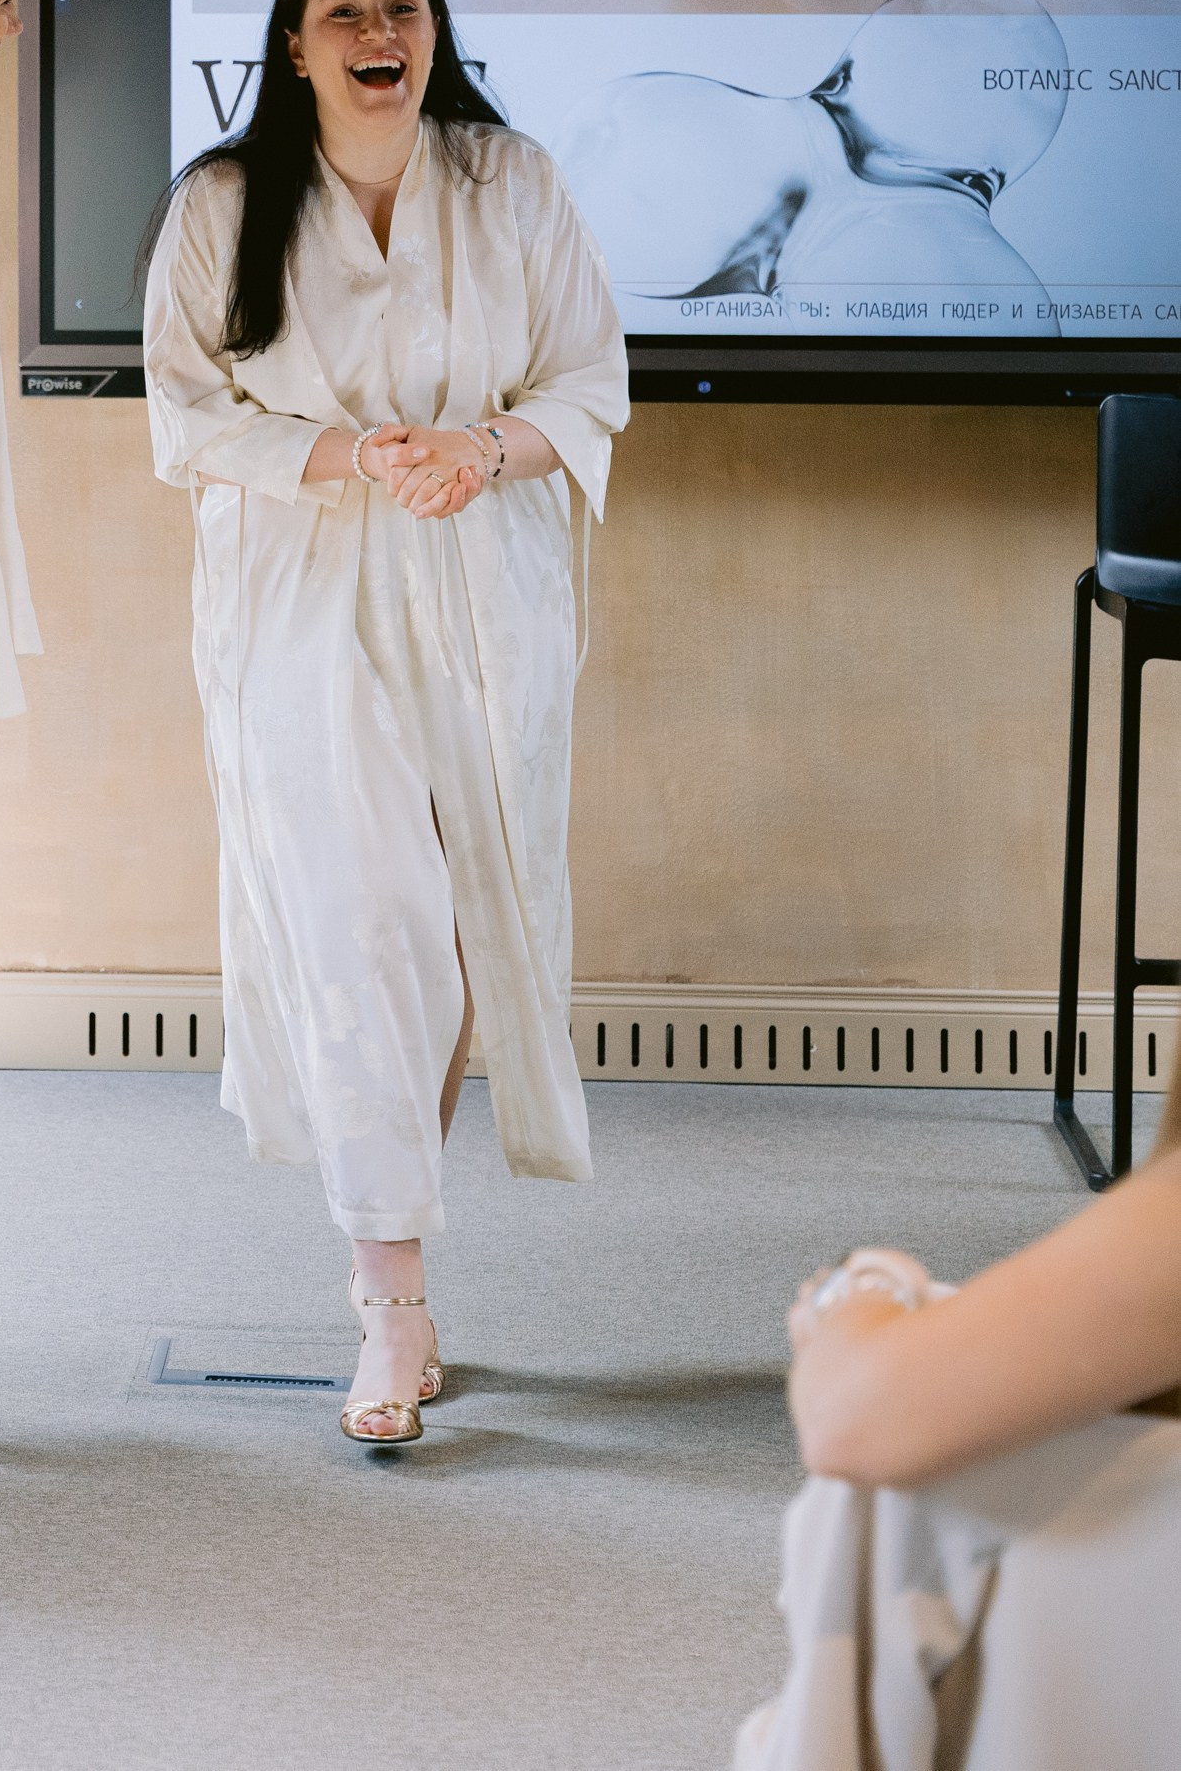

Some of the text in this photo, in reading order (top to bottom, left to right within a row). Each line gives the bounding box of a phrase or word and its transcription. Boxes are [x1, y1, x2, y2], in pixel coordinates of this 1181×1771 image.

[983, 69, 1093, 91] BOTANIC
[680, 301, 1181, 321] ОРГАНИЗАТРЫ: КЛАВДИЯ ГЮДЕР И ЕЛИЗАВЕТА СА
[27, 377, 83, 392] Prowise
